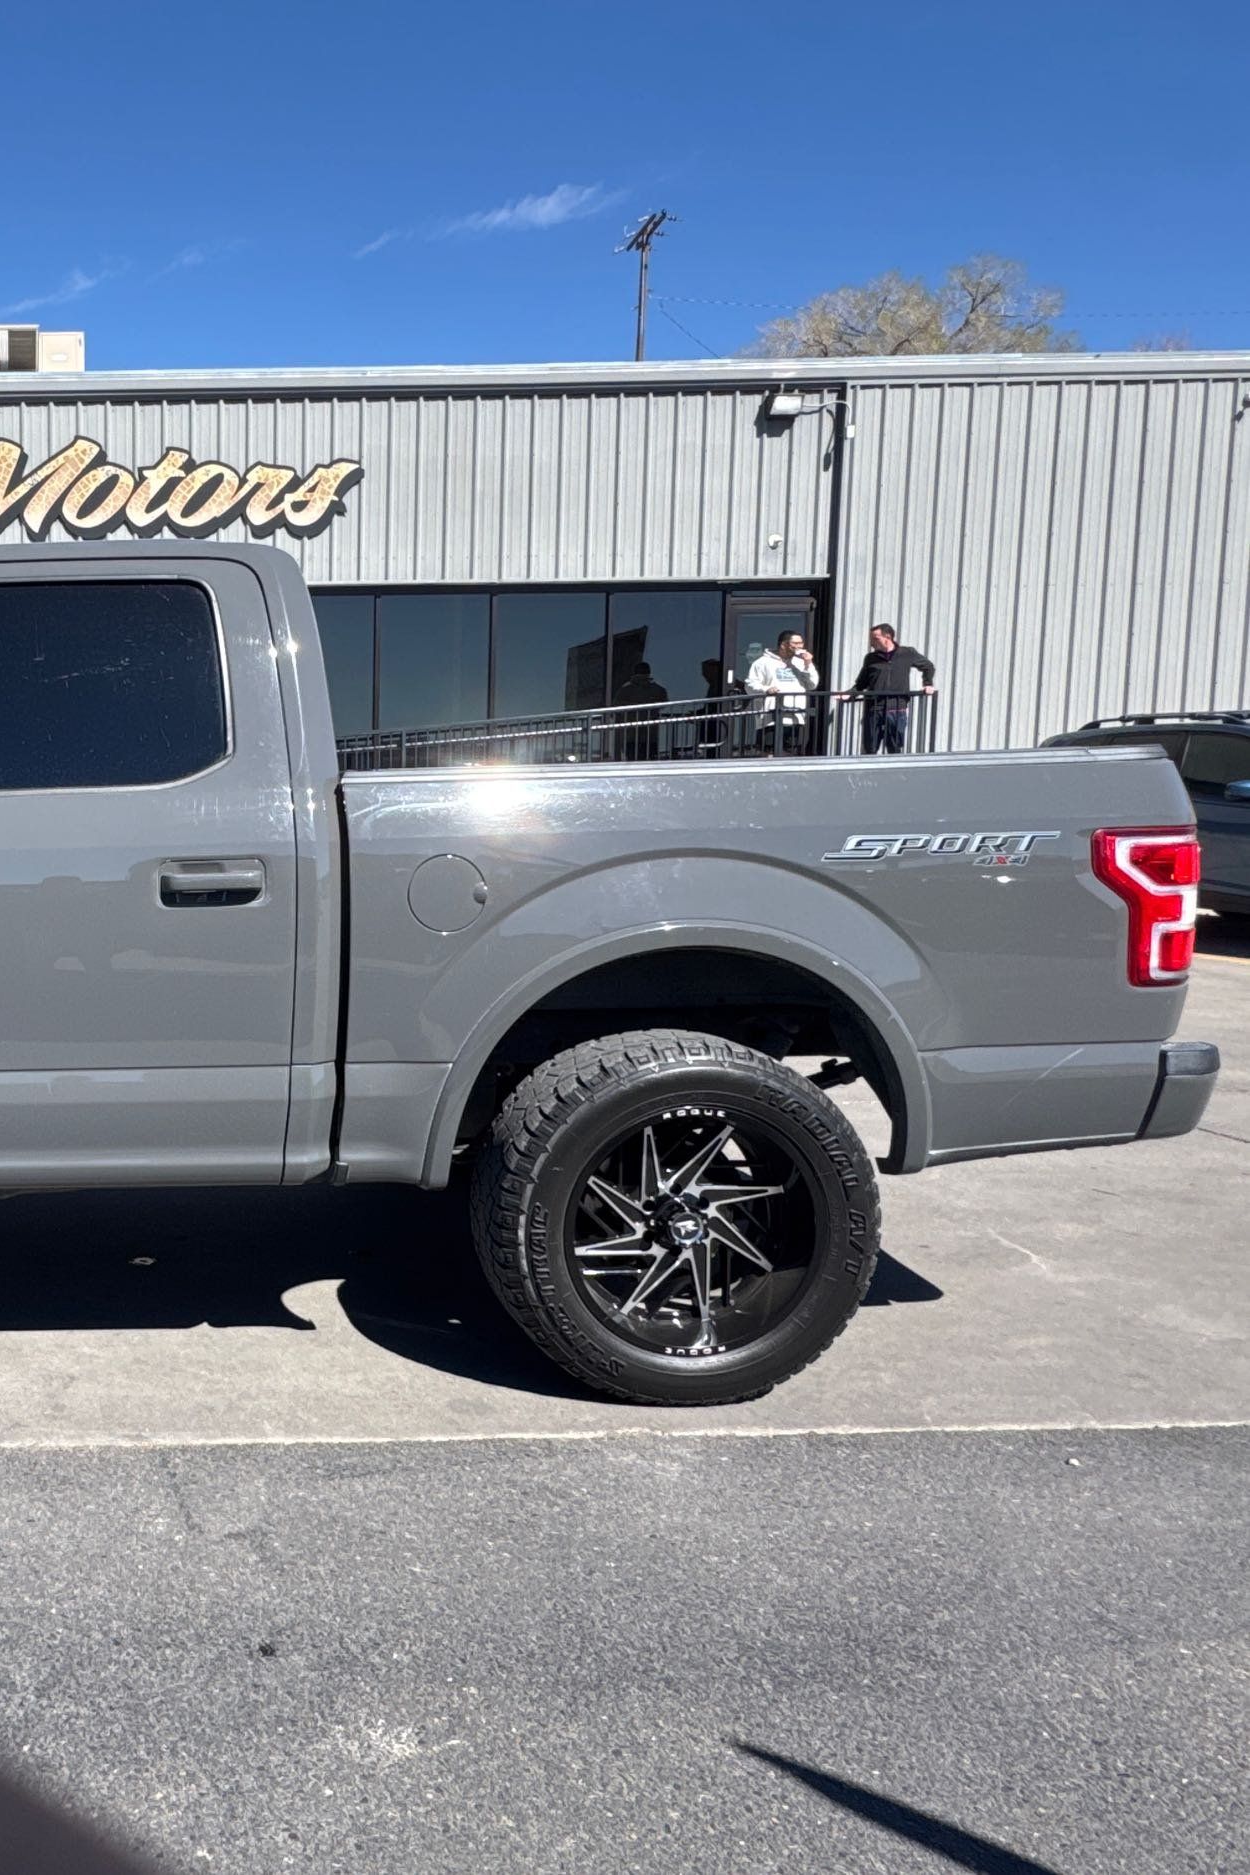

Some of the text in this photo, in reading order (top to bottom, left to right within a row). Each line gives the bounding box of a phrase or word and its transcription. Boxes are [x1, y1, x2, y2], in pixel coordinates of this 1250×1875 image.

[820, 831, 1061, 862] SPORT
[662, 1108, 726, 1120] ROGUE
[753, 1084, 860, 1201] RADIAL
[664, 1345, 726, 1356] ROGUE
